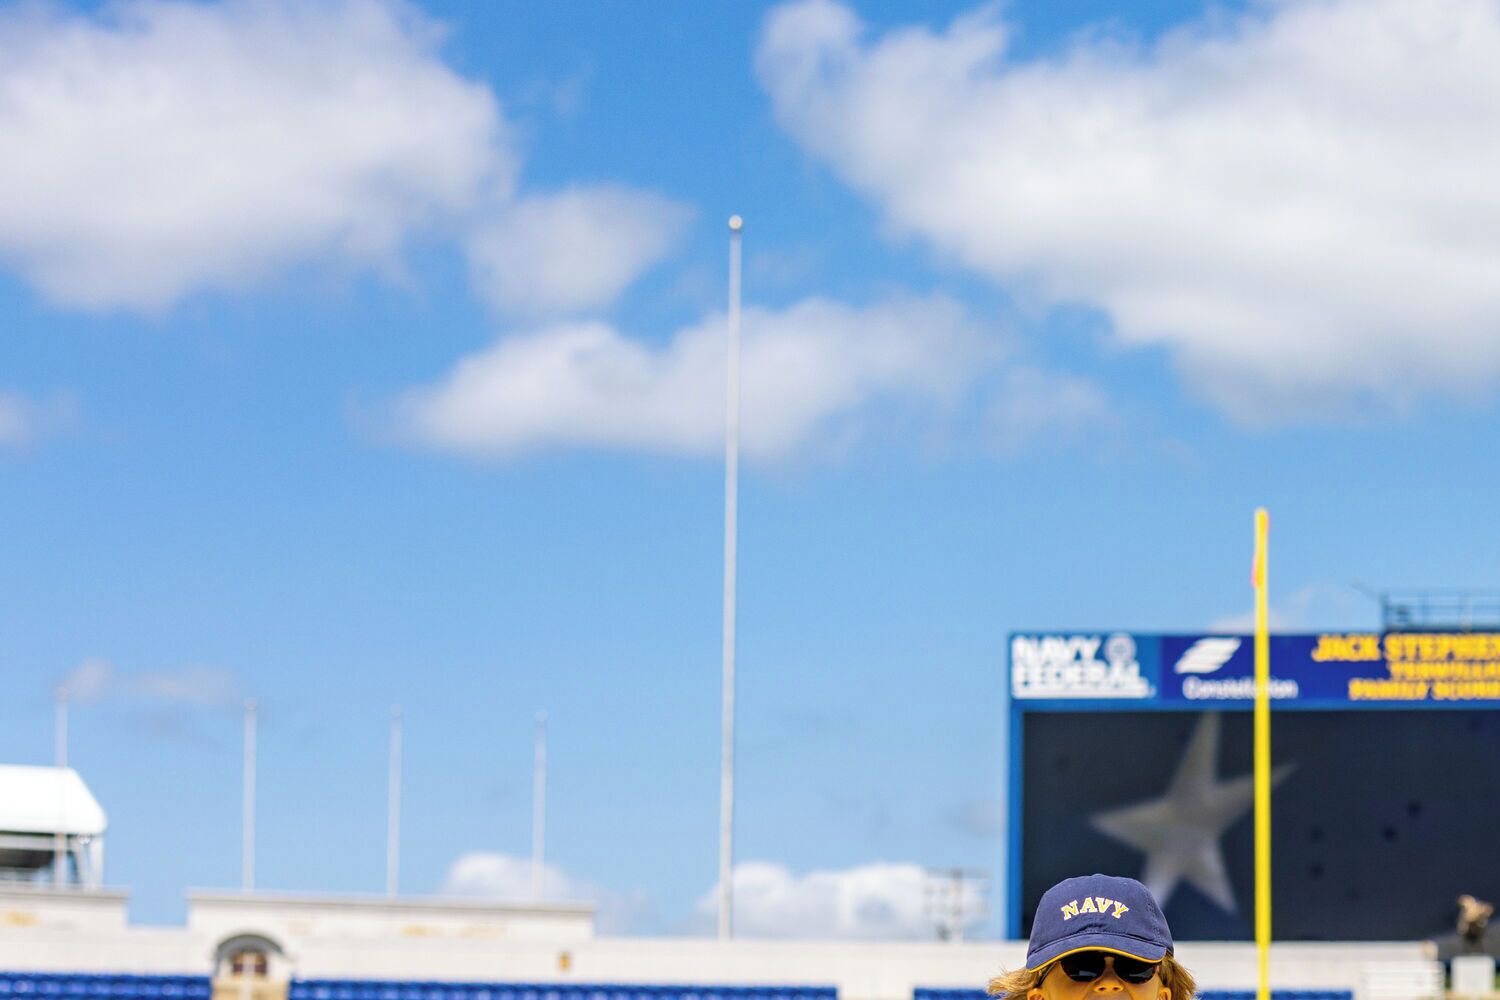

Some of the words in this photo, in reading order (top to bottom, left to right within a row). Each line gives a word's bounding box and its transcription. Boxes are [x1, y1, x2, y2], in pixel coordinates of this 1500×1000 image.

[1011, 635, 1101, 662] NAVY
[1311, 634, 1381, 662] JACK
[1011, 660, 1149, 693] FEDERAL
[1060, 896, 1129, 921] NAVY
